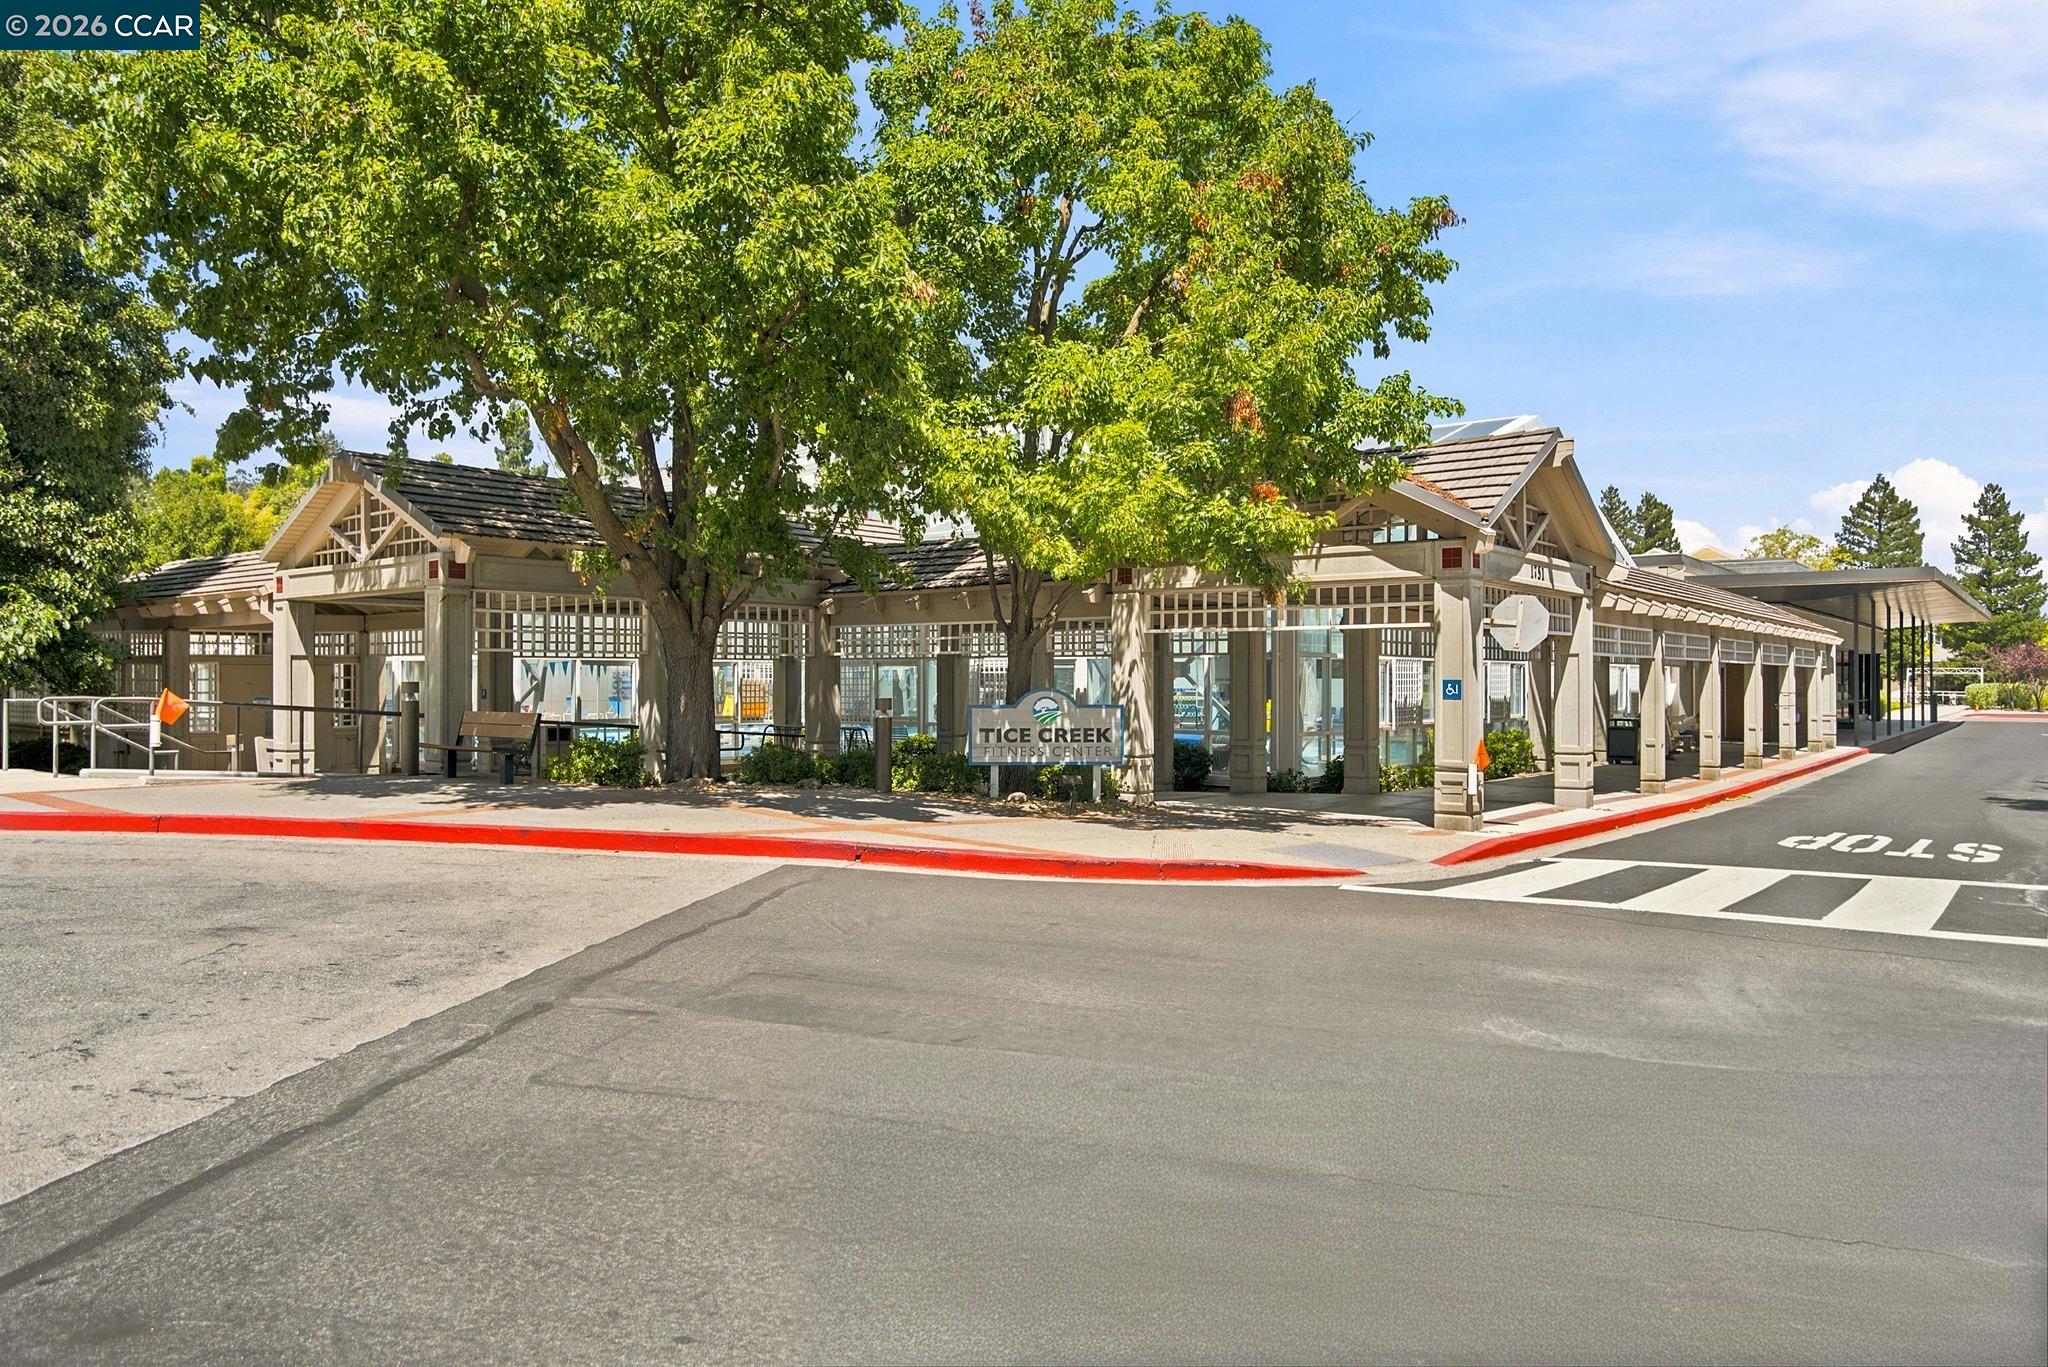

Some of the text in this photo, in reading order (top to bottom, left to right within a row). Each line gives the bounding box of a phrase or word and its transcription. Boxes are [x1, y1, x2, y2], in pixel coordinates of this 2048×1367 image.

[979, 728, 1112, 743] TICE CREEK
[984, 746, 1112, 757] FITNESS CENTER
[1777, 832, 2003, 863] STOP
